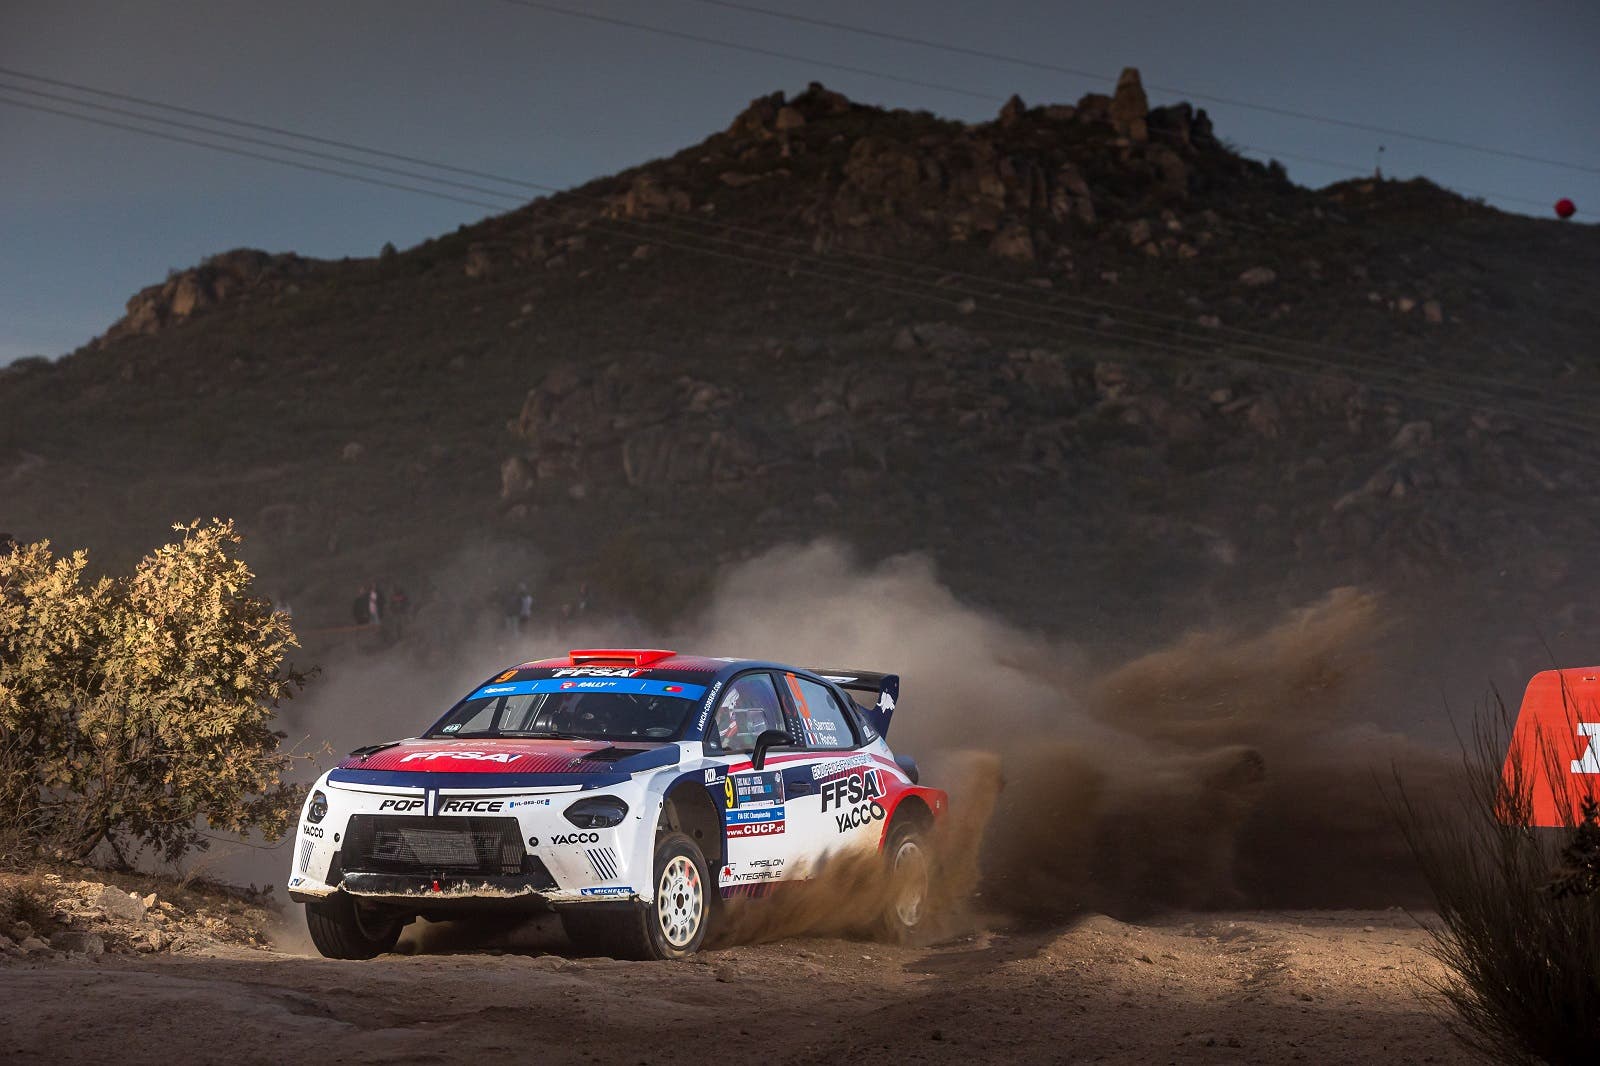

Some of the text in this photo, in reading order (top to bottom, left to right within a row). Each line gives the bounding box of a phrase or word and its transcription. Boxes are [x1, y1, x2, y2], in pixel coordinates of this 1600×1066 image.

[495, 670, 518, 683] 9
[552, 668, 632, 678] FFSA
[400, 751, 511, 764] FFSA
[725, 776, 734, 808] 9
[821, 770, 881, 813] FFSA
[380, 800, 504, 812] POP RACE
[836, 801, 886, 833] YACCO
[303, 824, 324, 839] YACCO
[551, 832, 600, 845] YACCO
